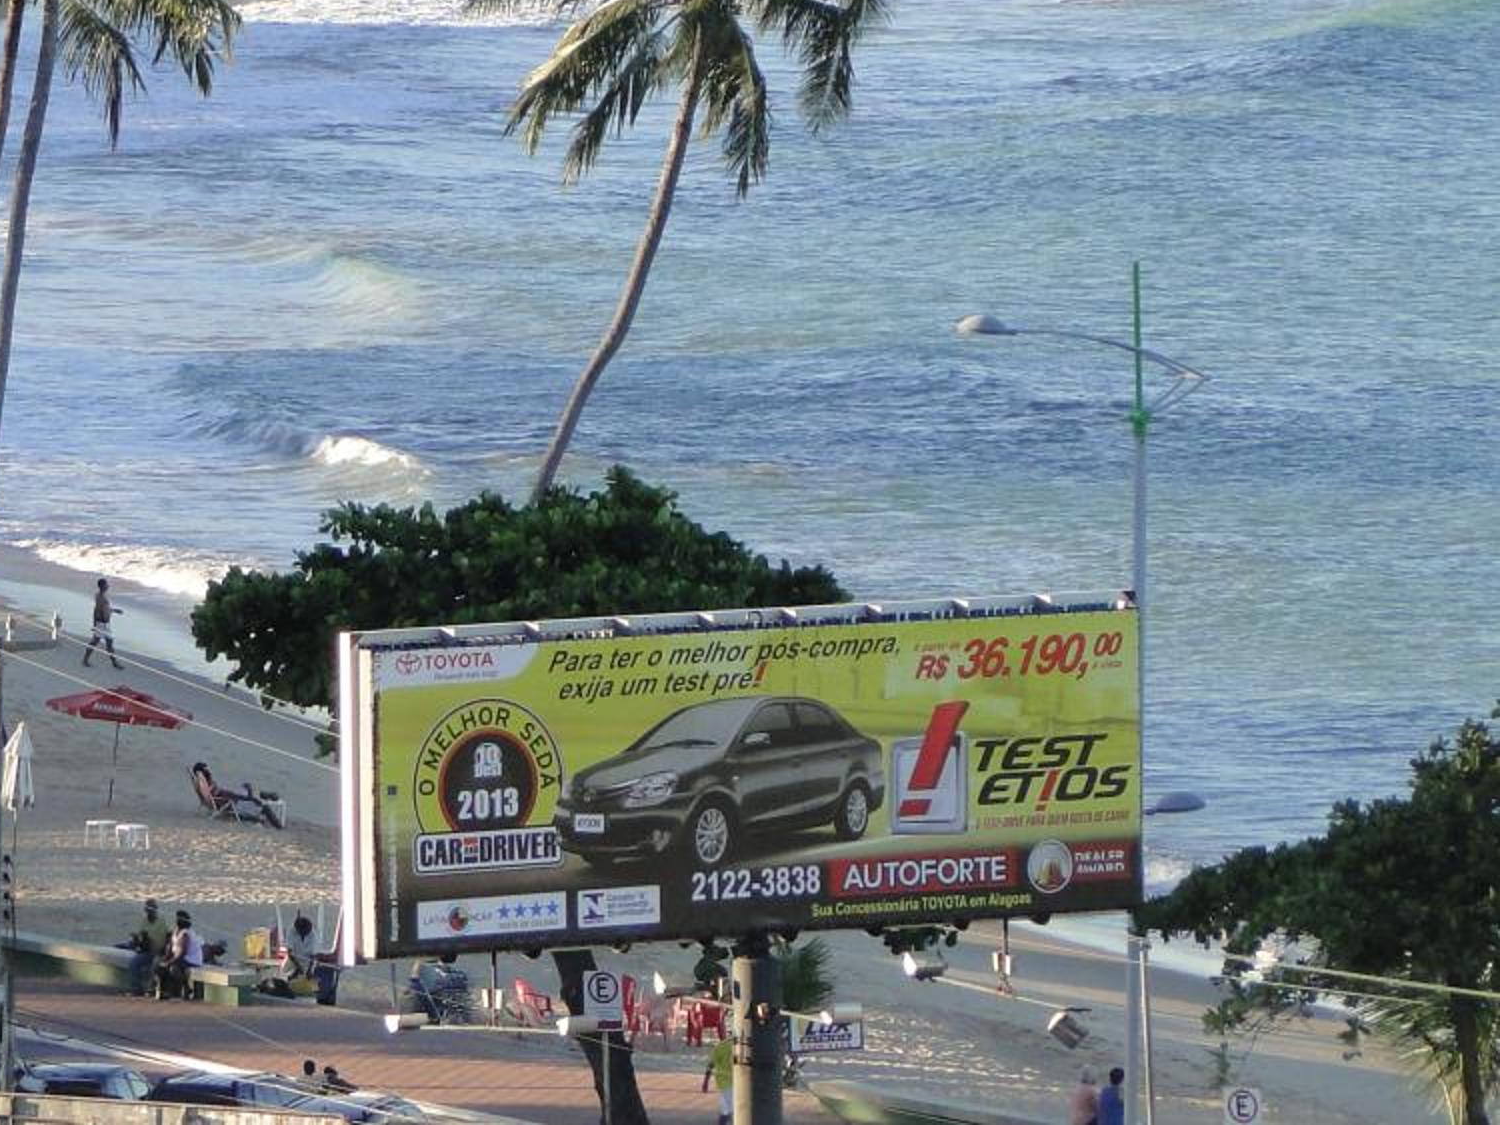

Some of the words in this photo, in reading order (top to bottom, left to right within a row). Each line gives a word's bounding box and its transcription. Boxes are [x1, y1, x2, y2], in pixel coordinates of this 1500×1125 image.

[424, 652, 494, 670] TOYOTA
[549, 649, 601, 674] Para
[609, 648, 640, 670] ter
[647, 649, 663, 666] o
[669, 640, 752, 665] melhor
[754, 635, 901, 667] pós-compra,
[916, 654, 950, 681] R$
[1093, 631, 1123, 657] 00
[558, 675, 614, 703] exija
[621, 679, 657, 695] um
[664, 671, 708, 693] test
[424, 706, 511, 771] MELHOR
[975, 733, 1108, 772] TEST
[419, 779, 435, 795] O
[457, 787, 519, 820] 2013
[419, 838, 463, 868] CAR
[480, 831, 558, 863] DRIVER
[691, 864, 821, 901] 2122-3838
[844, 856, 1007, 890] AUTOFORTE
[811, 903, 833, 918] Sua
[922, 894, 966, 909] TOYOTA
[970, 895, 987, 906] em
[988, 892, 1032, 909] Alagoas
[597, 977, 610, 998] E
[1235, 1094, 1251, 1117] E
